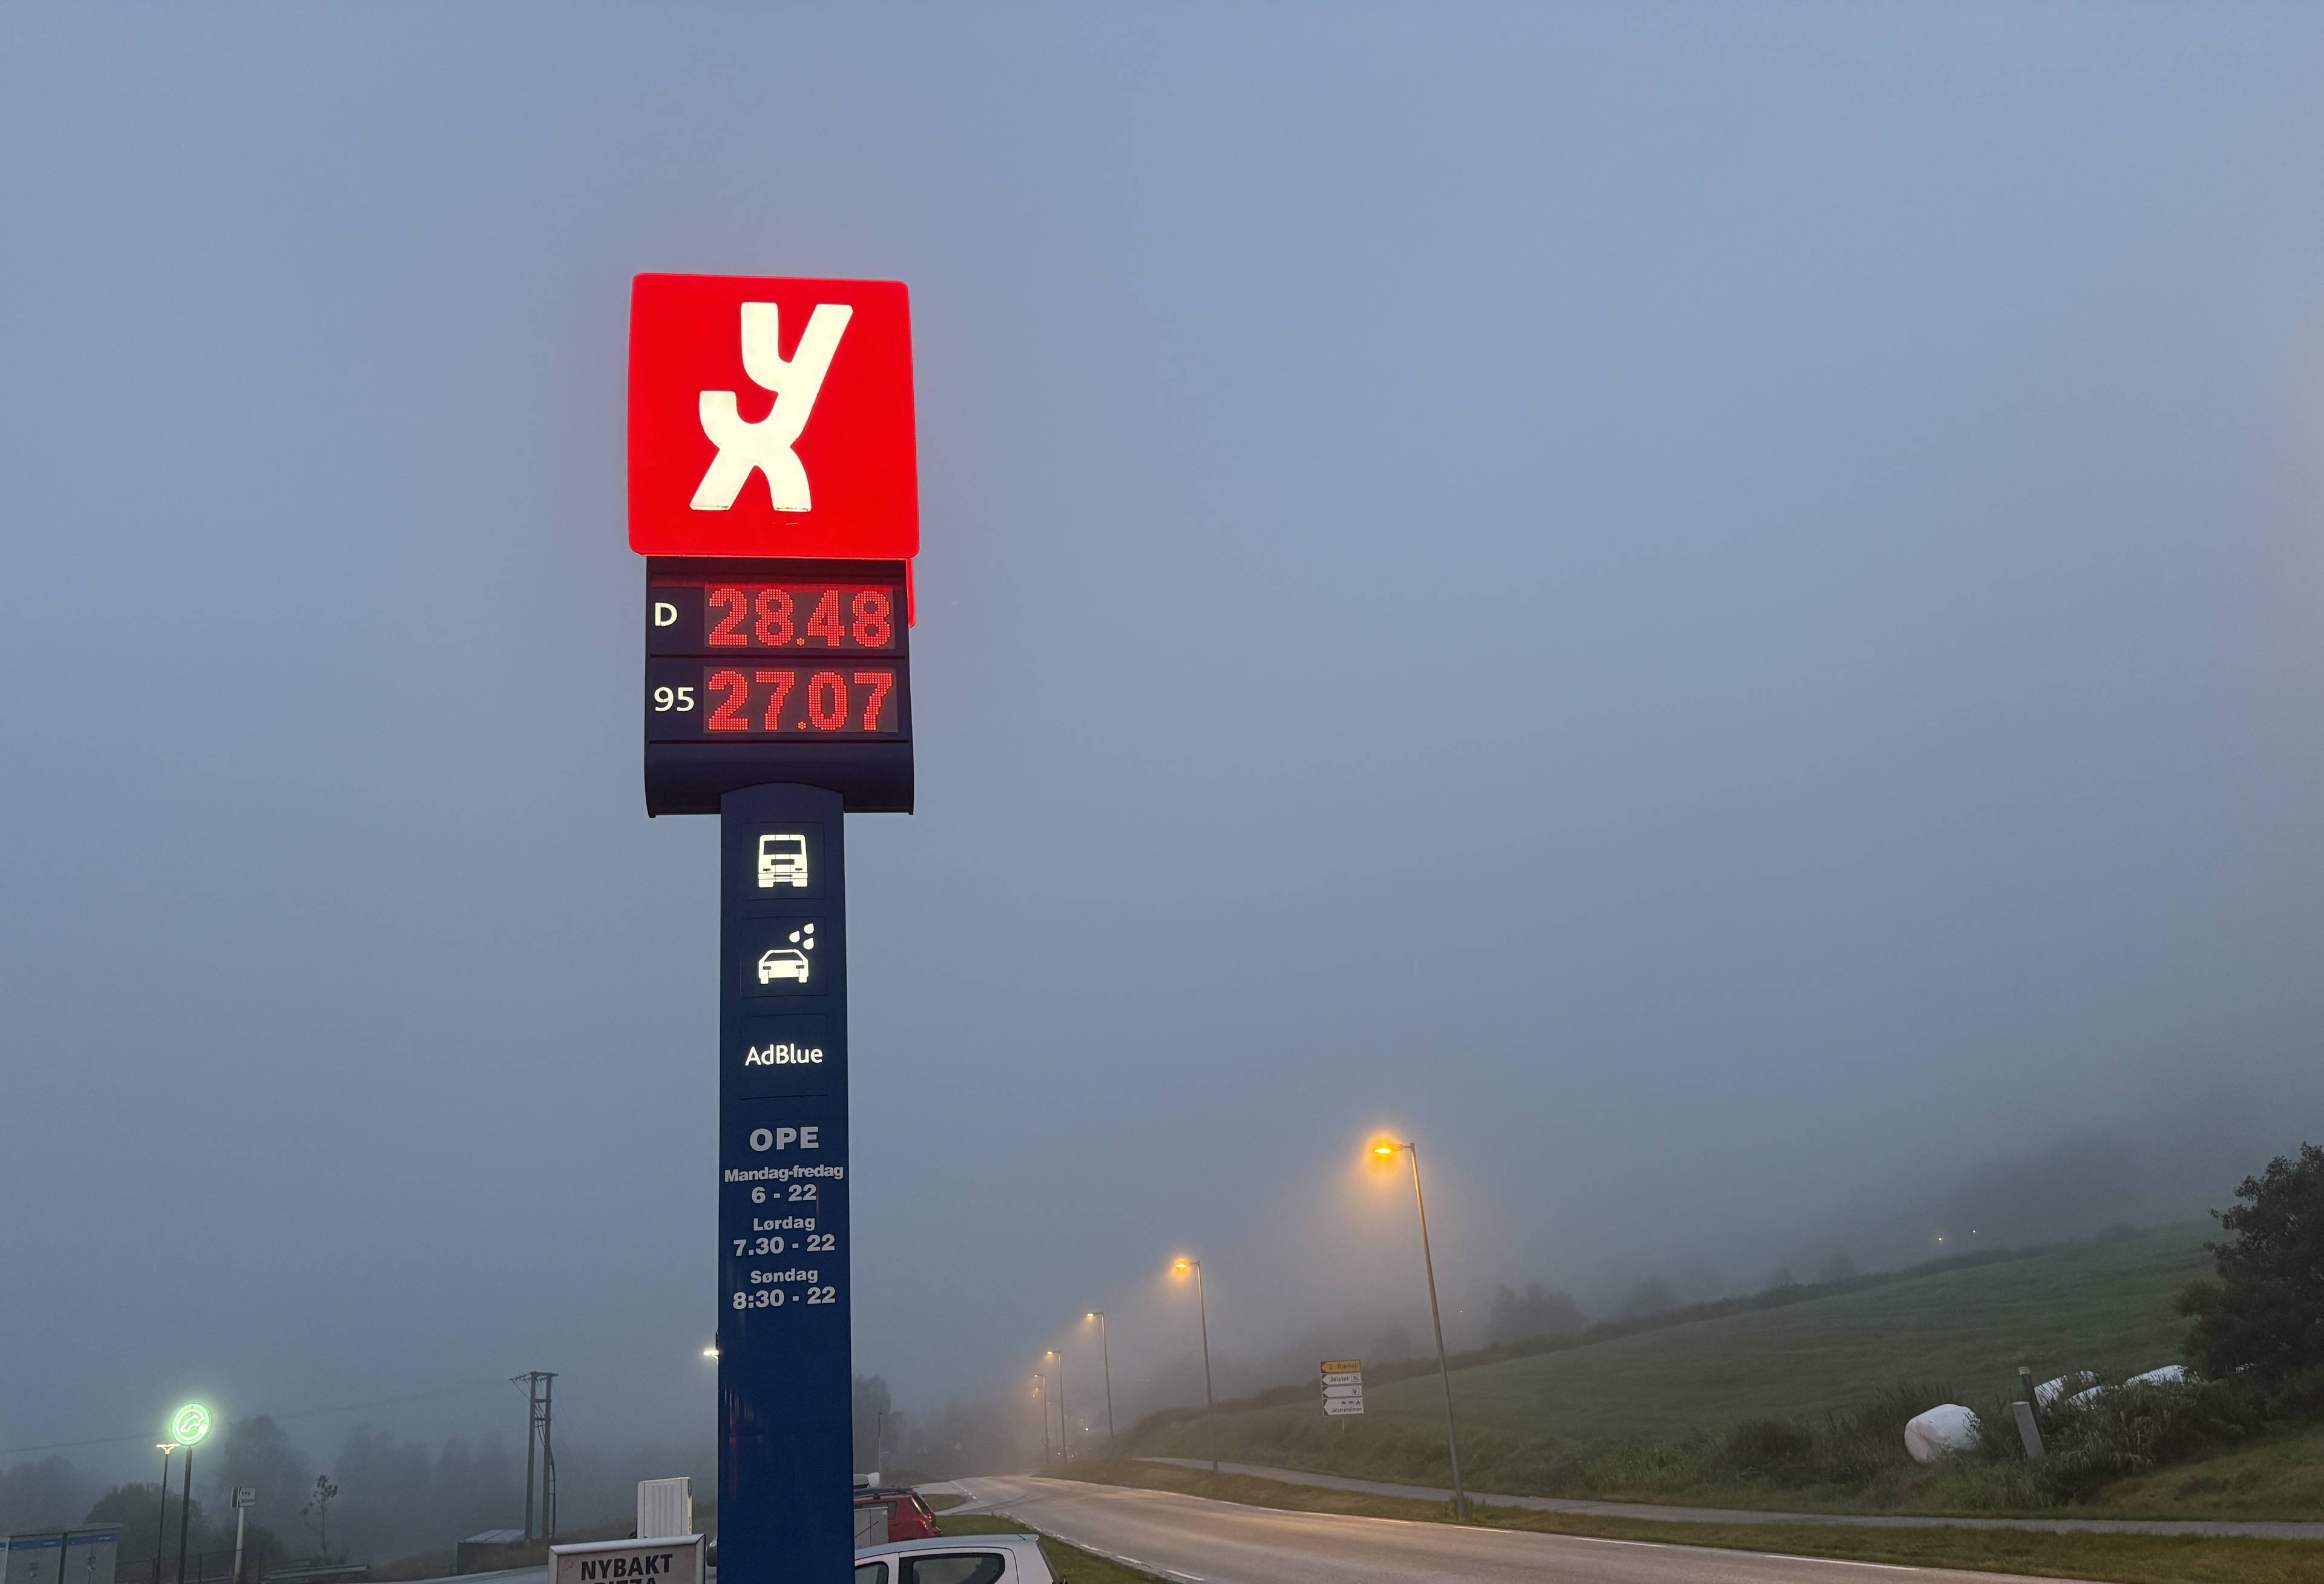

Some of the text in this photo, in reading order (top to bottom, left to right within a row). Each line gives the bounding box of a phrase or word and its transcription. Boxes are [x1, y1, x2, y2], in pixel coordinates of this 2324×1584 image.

[654, 588, 891, 648] D 28.48
[654, 670, 893, 731] 95 27.07
[744, 1043, 823, 1066] AdBlue
[749, 1126, 819, 1152] OPE
[724, 1164, 844, 1183] Mandag-fredag
[752, 1186, 766, 1204] 6
[788, 1184, 817, 1201] 22
[753, 1216, 815, 1231] Lørdag
[733, 1237, 784, 1257] 7.30
[807, 1234, 835, 1252] 22
[750, 1268, 818, 1284] Søndag
[732, 1289, 785, 1310] 8:30
[807, 1286, 836, 1304] 22
[581, 1554, 674, 1580] NYBAKT
